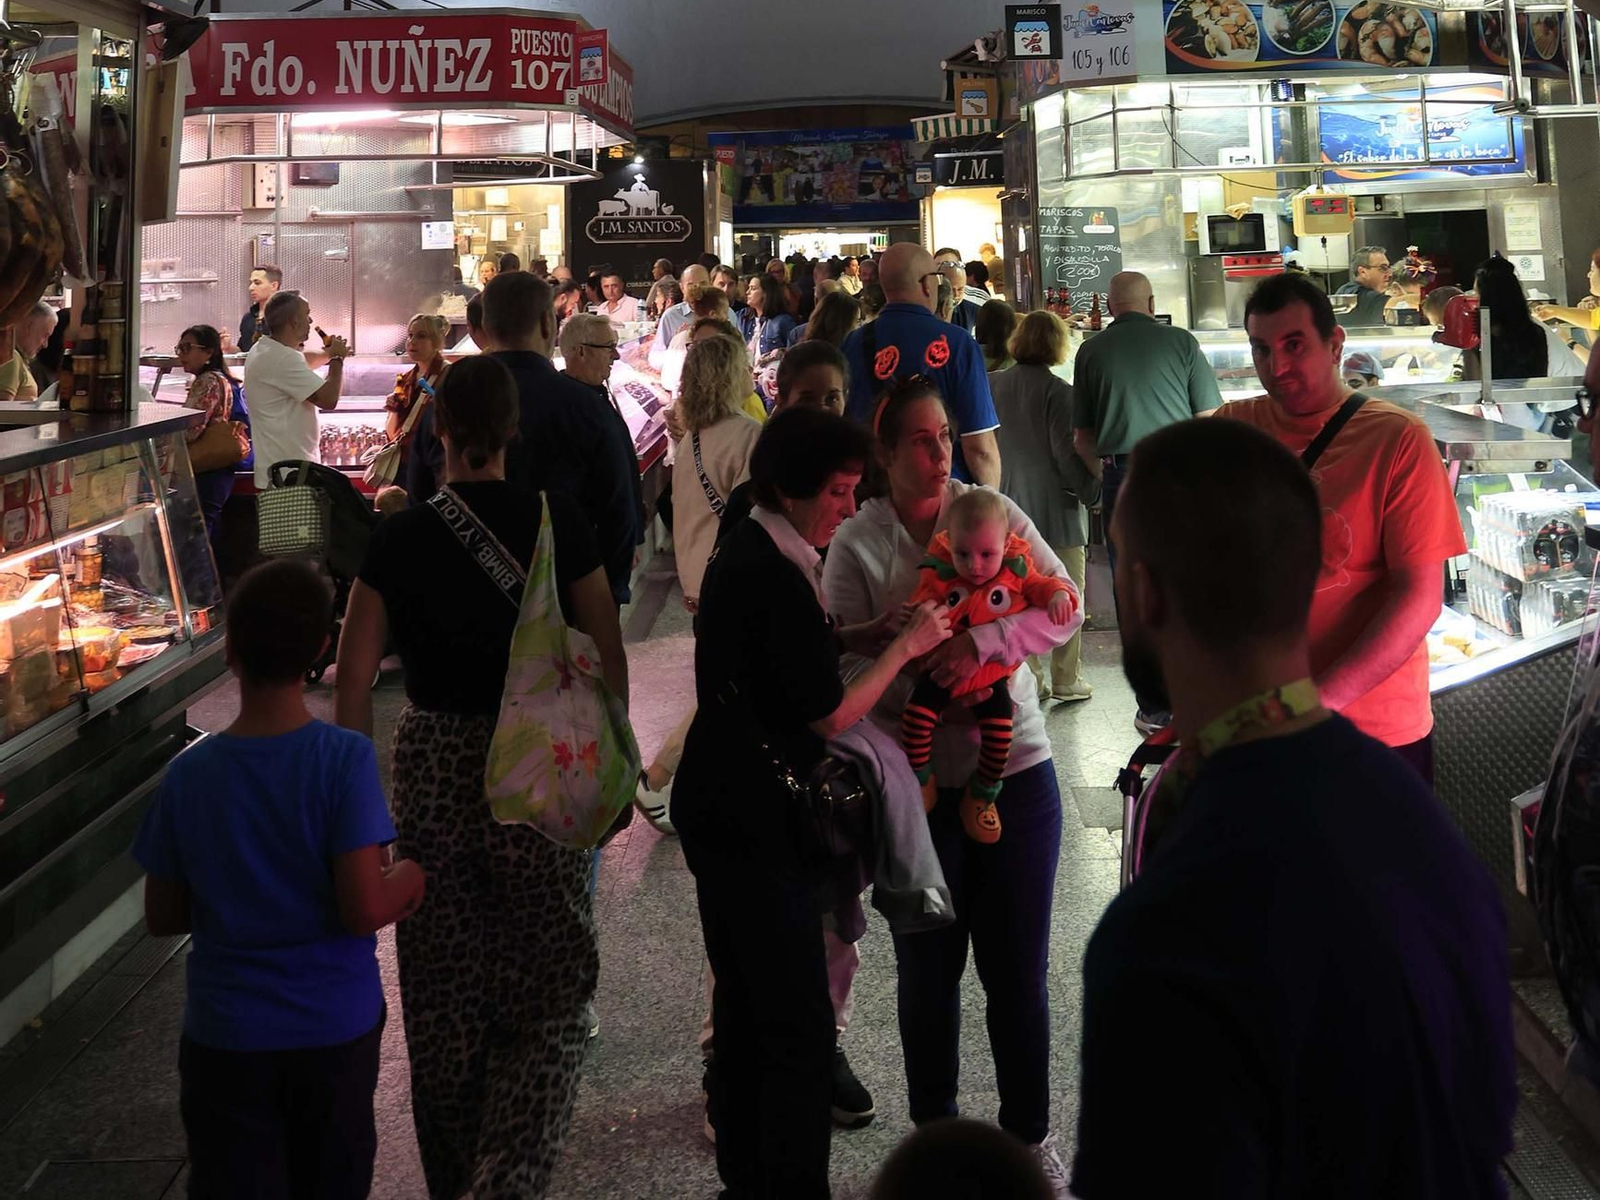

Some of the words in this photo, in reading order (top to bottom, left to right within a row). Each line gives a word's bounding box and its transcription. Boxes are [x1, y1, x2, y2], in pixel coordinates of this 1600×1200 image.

[1016, 8, 1046, 16] MARISCO
[510, 29, 571, 58] PUESTO
[220, 39, 316, 97] Fdo.
[335, 25, 493, 95] NUÑEZ
[1072, 49, 1092, 70] 105
[1096, 57, 1104, 75] y
[1109, 45, 1130, 66] 106
[511, 59, 571, 91] 107
[948, 158, 995, 185] J.M.
[1039, 208, 1084, 217] MARISCOS
[600, 221, 625, 236] J.M.
[628, 220, 681, 234] SANTOS
[1053, 217, 1061, 225] Y
[1040, 225, 1076, 234] TAPAS
[1045, 256, 1051, 267] Y
[460, 526, 475, 543] Y
